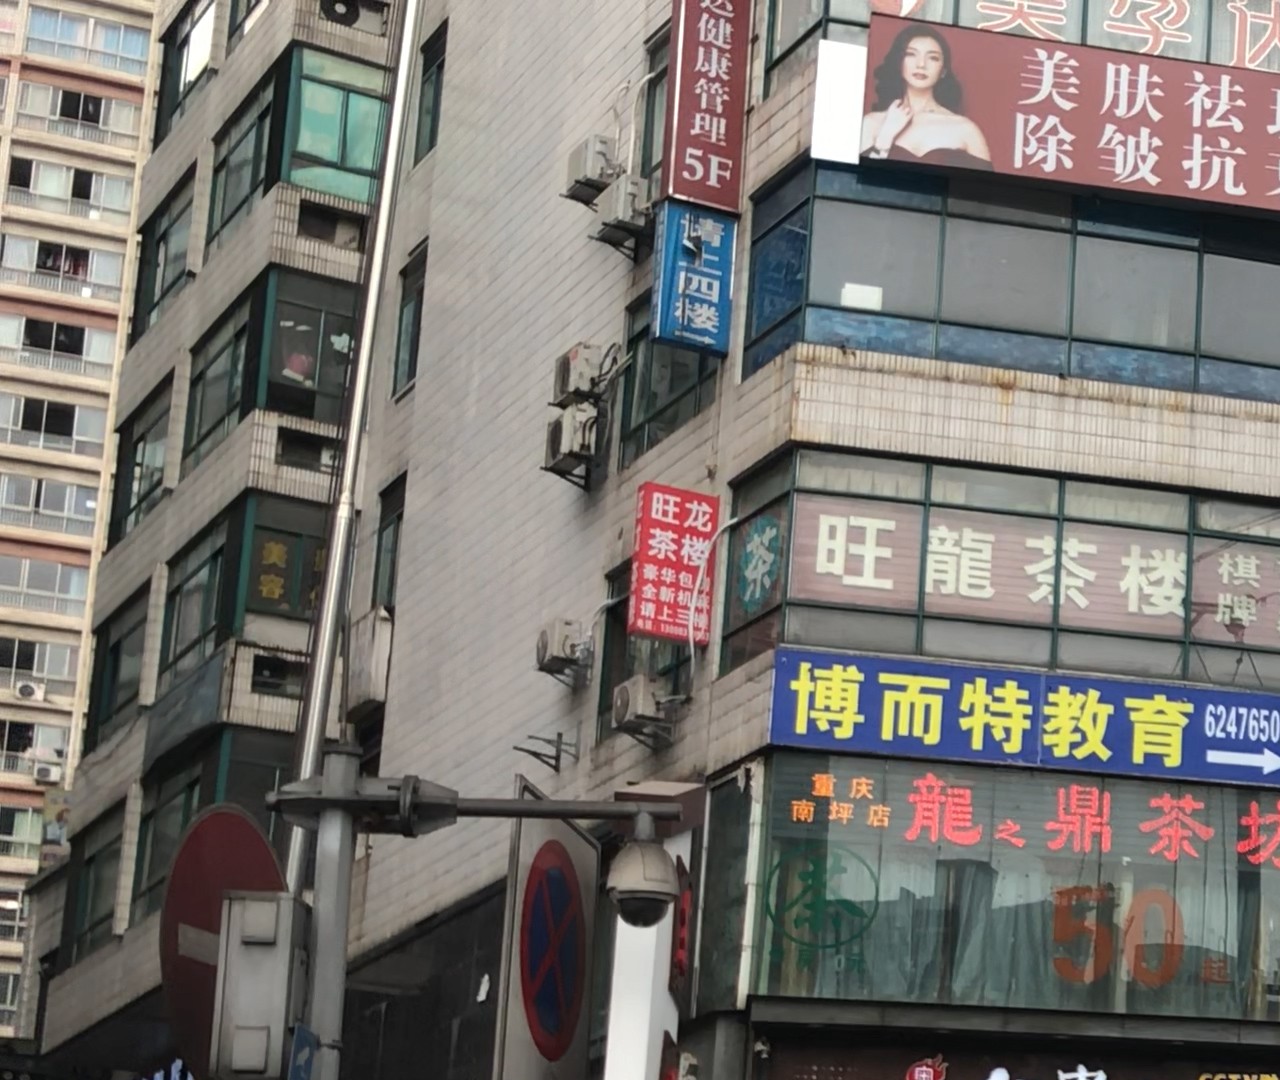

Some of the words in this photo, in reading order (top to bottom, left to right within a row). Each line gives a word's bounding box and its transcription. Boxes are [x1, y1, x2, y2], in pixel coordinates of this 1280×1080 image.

[682, 147, 734, 189] 5F
[673, 212, 725, 335] 请上四楼
[651, 491, 713, 533] 旺龙
[648, 526, 710, 567] 茶楼
[744, 525, 777, 602] 茶
[815, 513, 1191, 619] 旺龍茶楼
[1214, 552, 1262, 628] 棋牌
[789, 661, 1195, 769] 博而特教育
[790, 799, 893, 828] 南坪店
[811, 772, 875, 800] 重庆
